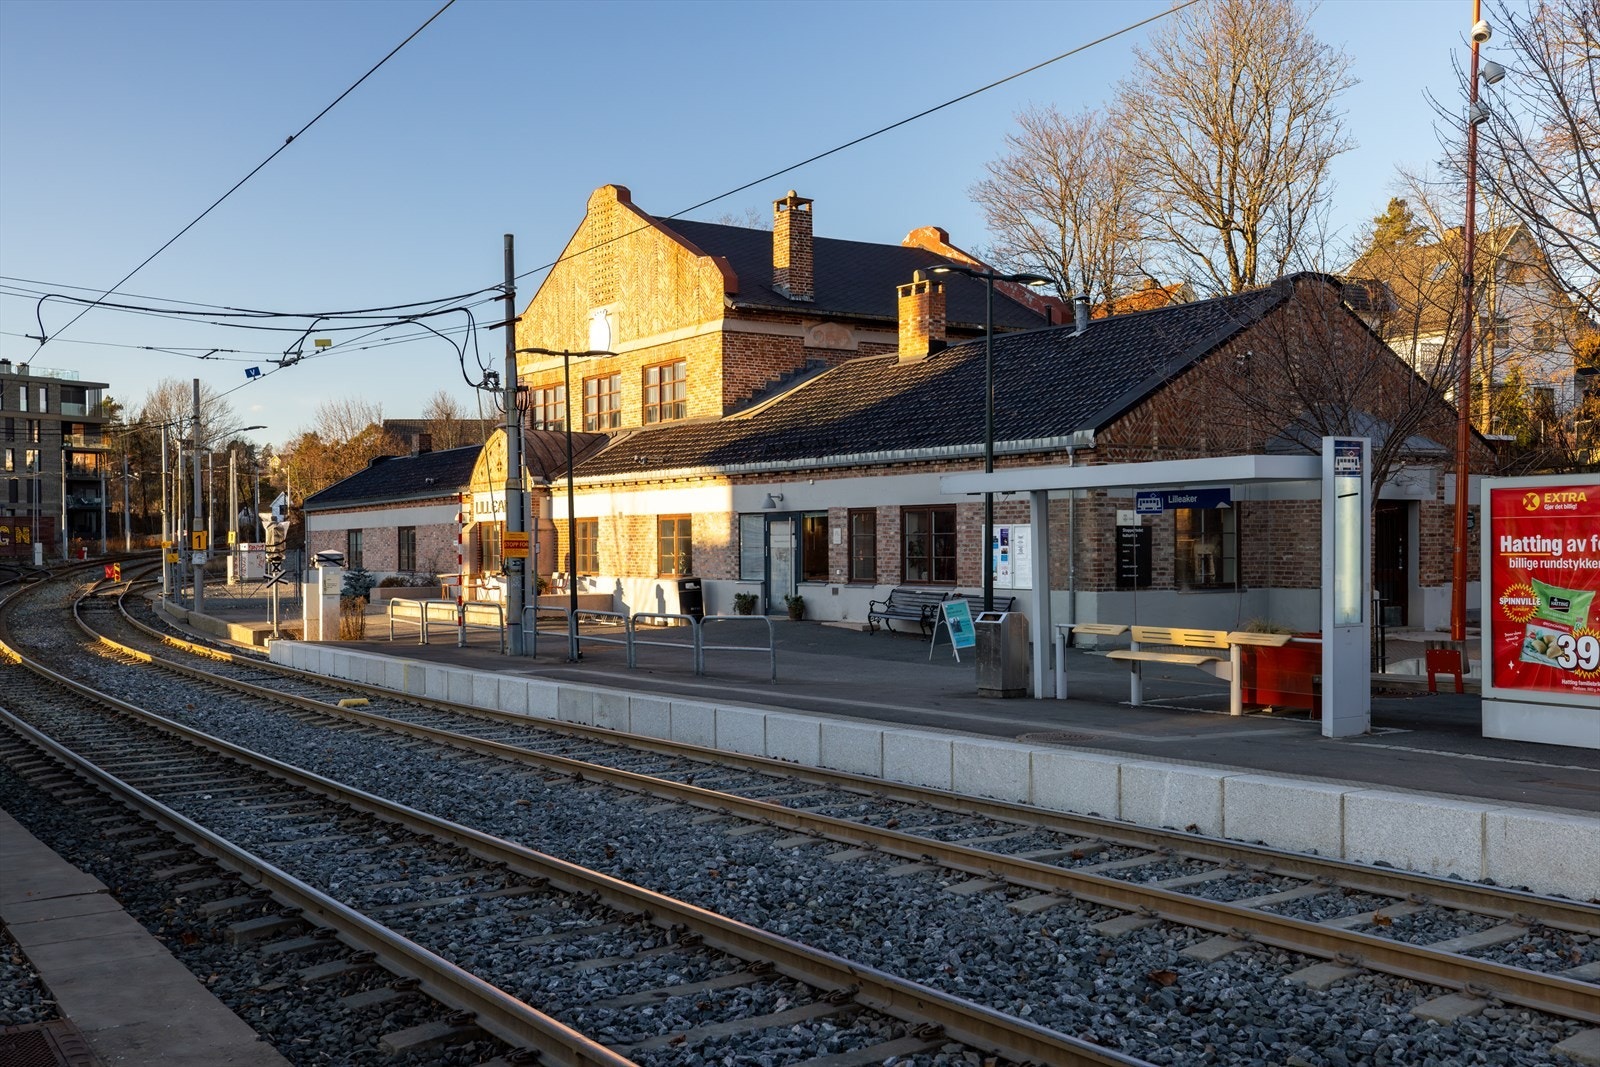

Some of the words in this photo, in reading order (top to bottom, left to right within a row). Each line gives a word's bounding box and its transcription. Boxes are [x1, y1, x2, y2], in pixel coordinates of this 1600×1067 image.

[1168, 495, 1198, 504] Lilleaker
[1544, 491, 1587, 503] EXTRA
[475, 500, 507, 514] LILLEA
[195, 534, 201, 548] 1
[1500, 534, 1563, 556] Hatting
[1566, 538, 1587, 552] av
[1509, 557, 1538, 571] billige
[1499, 597, 1541, 606] SPINNVILLE
[1557, 633, 1600, 671] 39
